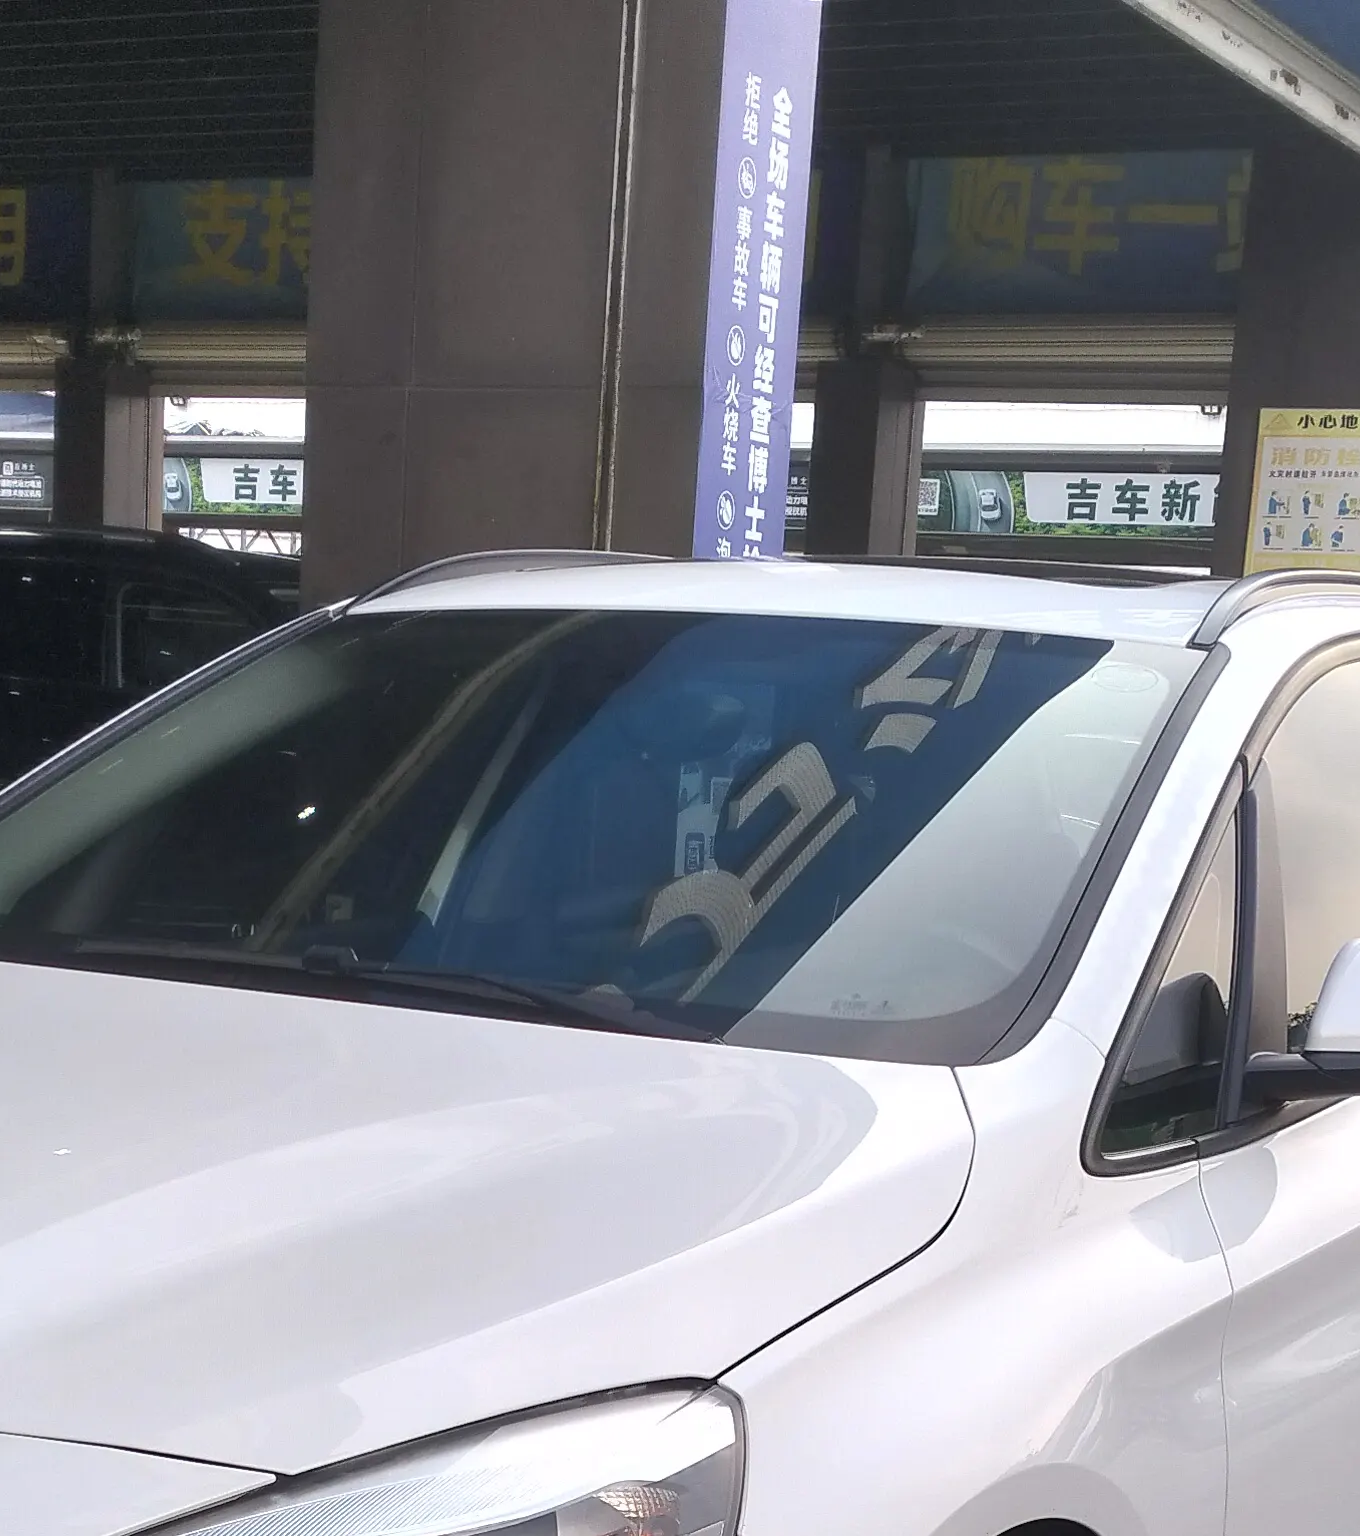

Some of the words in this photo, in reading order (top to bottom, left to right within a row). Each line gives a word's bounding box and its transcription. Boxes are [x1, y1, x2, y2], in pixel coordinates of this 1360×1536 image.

[742, 72, 762, 146] 拒绝
[178, 181, 312, 287] 支持
[731, 205, 753, 312] 事故车
[719, 373, 742, 476] 火烧车
[232, 463, 297, 501] 吉车
[1064, 478, 1218, 525] 吉车新
